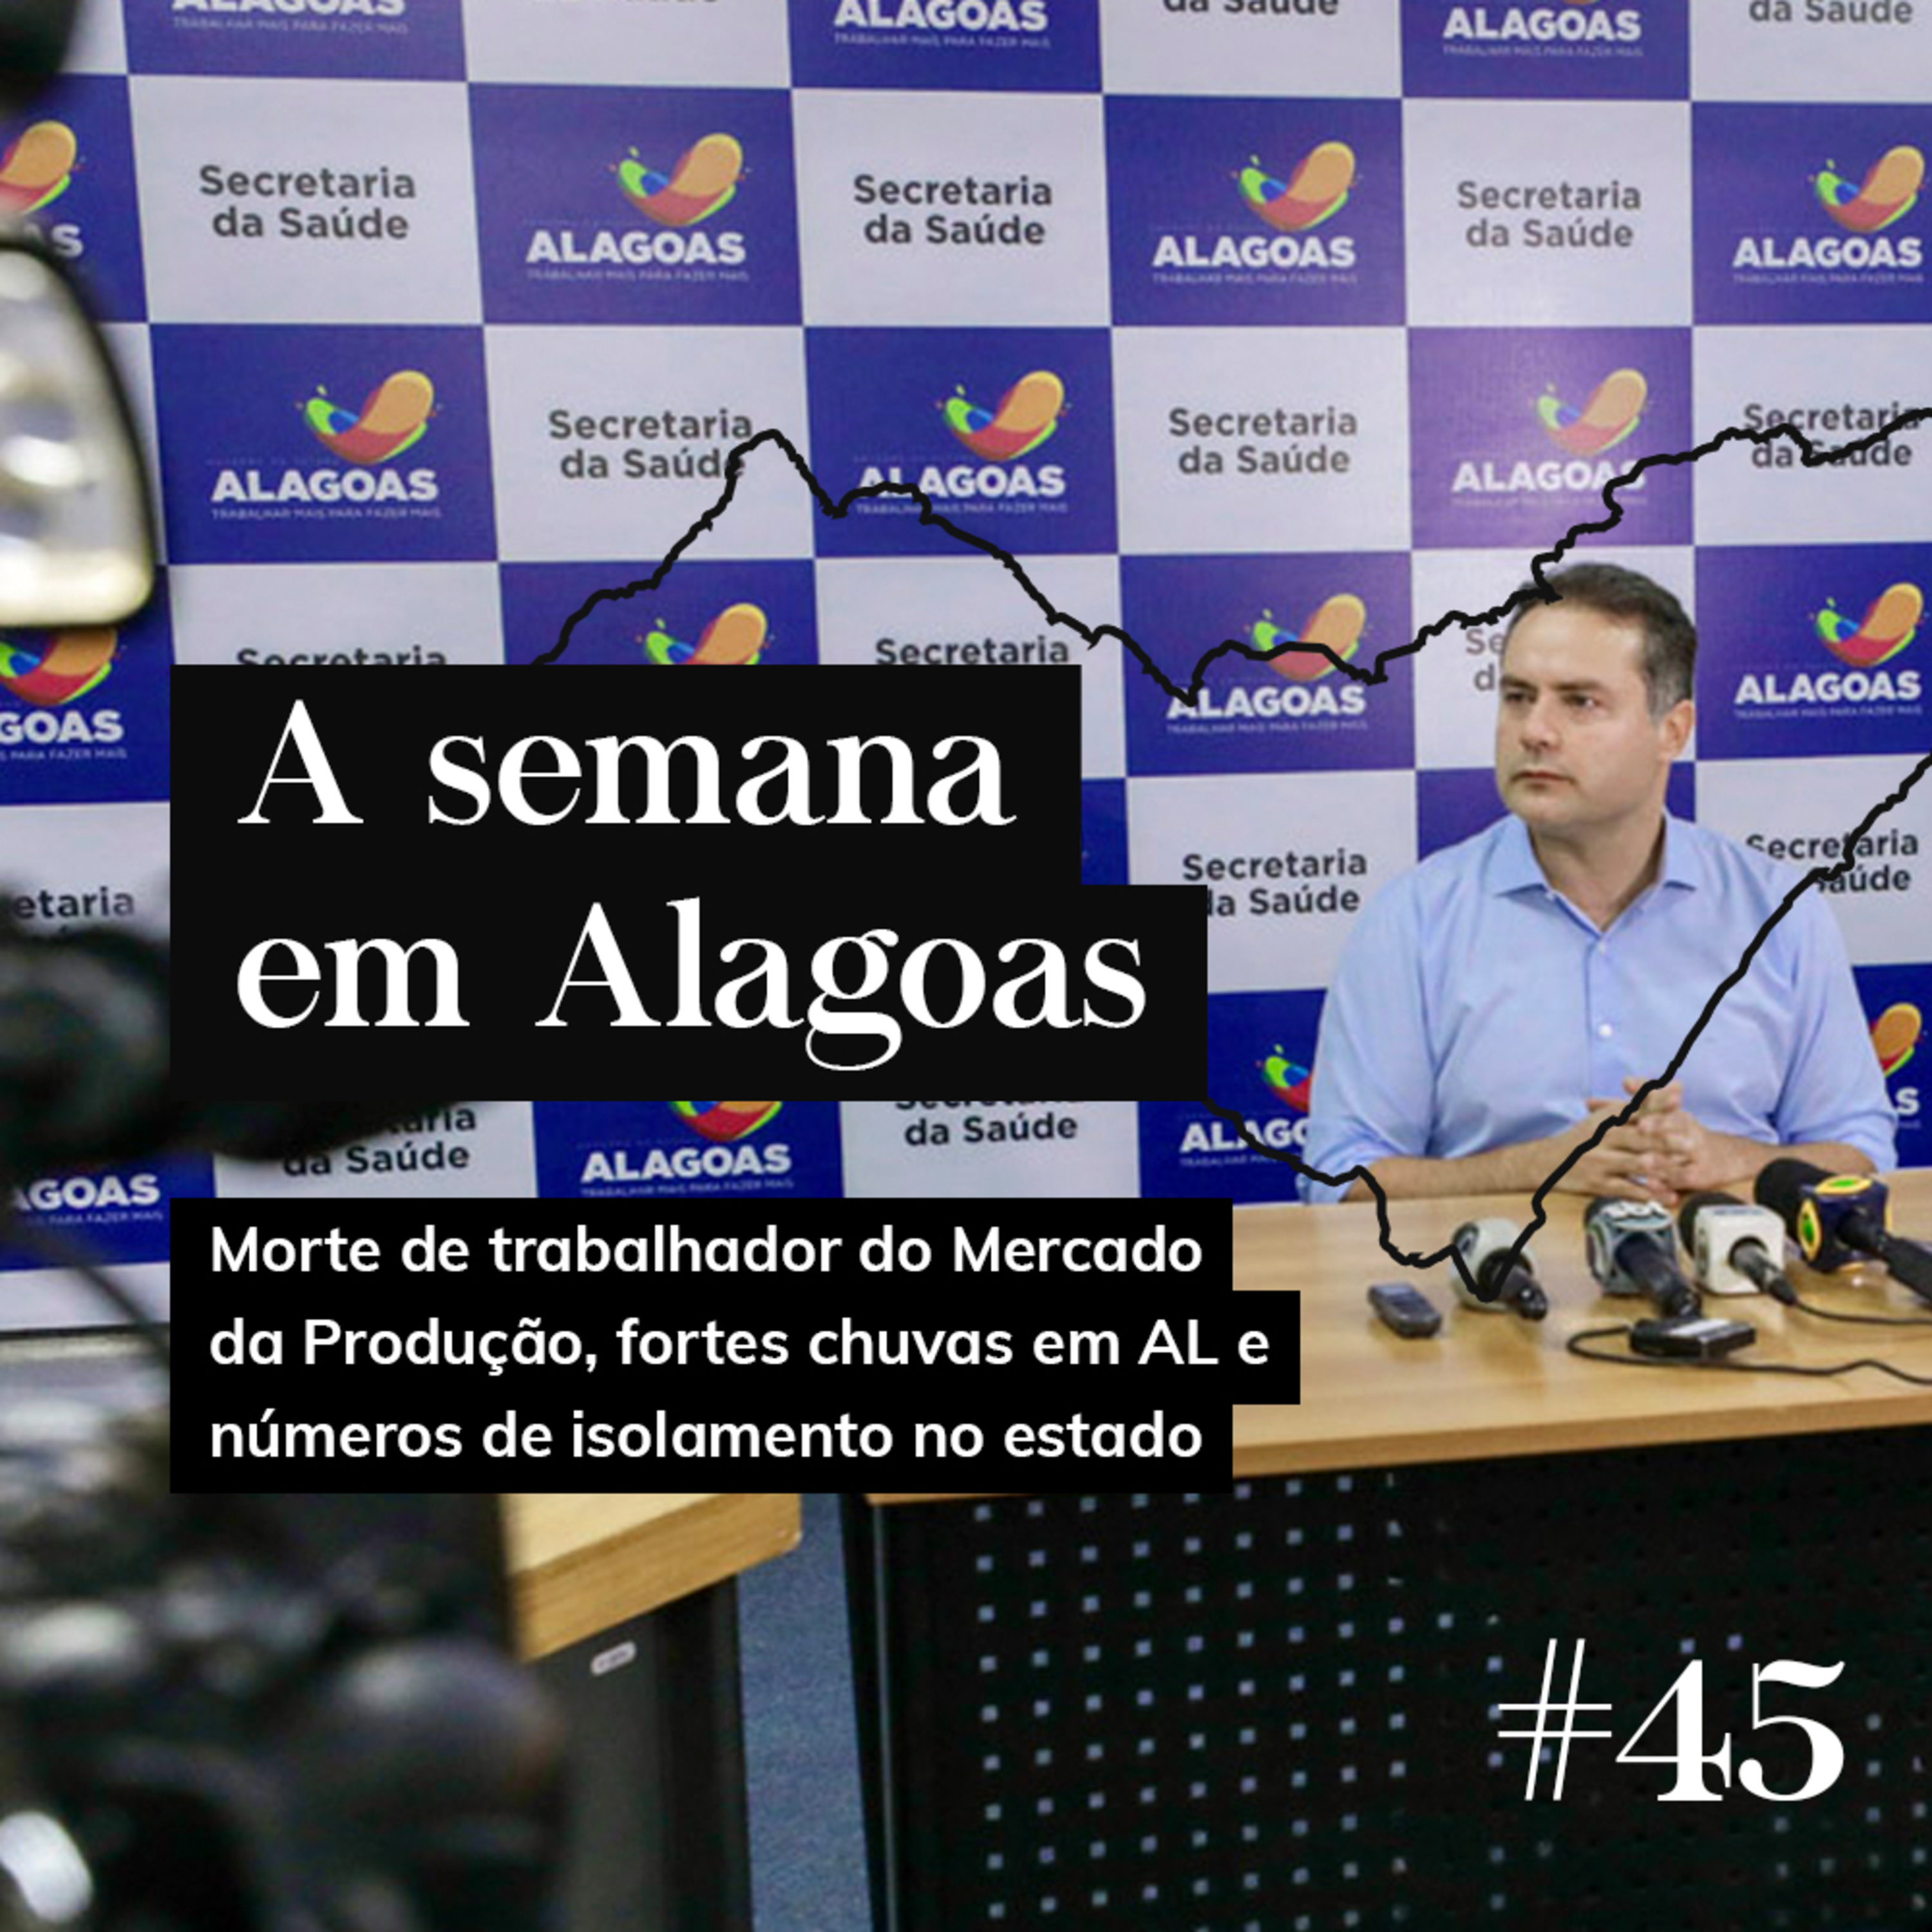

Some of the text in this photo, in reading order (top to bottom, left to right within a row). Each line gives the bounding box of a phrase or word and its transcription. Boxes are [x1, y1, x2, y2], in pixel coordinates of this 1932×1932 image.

[835, 0, 1047, 30] ALAGOAS
[1444, 8, 1641, 41] ALAGOAS
[1750, 0, 1791, 22] da
[200, 164, 415, 198] Secretaria
[854, 174, 1052, 206] Secretaria
[1458, 180, 1641, 210] Secretaria
[213, 205, 408, 240] da Saúde
[864, 213, 1045, 245] da Saúde
[1466, 218, 1633, 247] da Saúde
[527, 231, 745, 264] ALAGOAS
[1153, 236, 1356, 267] ALAGOAS
[1734, 238, 1922, 267] ALAGOAS
[549, 409, 752, 439] Secretaria
[1169, 407, 1357, 437] Secretaria
[560, 448, 609, 479] da
[1179, 444, 1350, 475] da Saúde
[1752, 439, 1793, 468] da
[212, 469, 438, 502] ALAGOAS
[1452, 461, 1645, 493] ALAGOAS
[876, 635, 1069, 665] Secretaria
[1736, 672, 1922, 704] ALAGOAS
[1746, 829, 1918, 860] Secrearia
[1182, 848, 1367, 882] Secretaria
[1816, 864, 1911, 893] aúde
[1208, 884, 1361, 917] a Saúde
[904, 1112, 1079, 1147] da Saúde
[345, 1141, 470, 1175] Saúde
[581, 1144, 791, 1182] ALAGOAS
